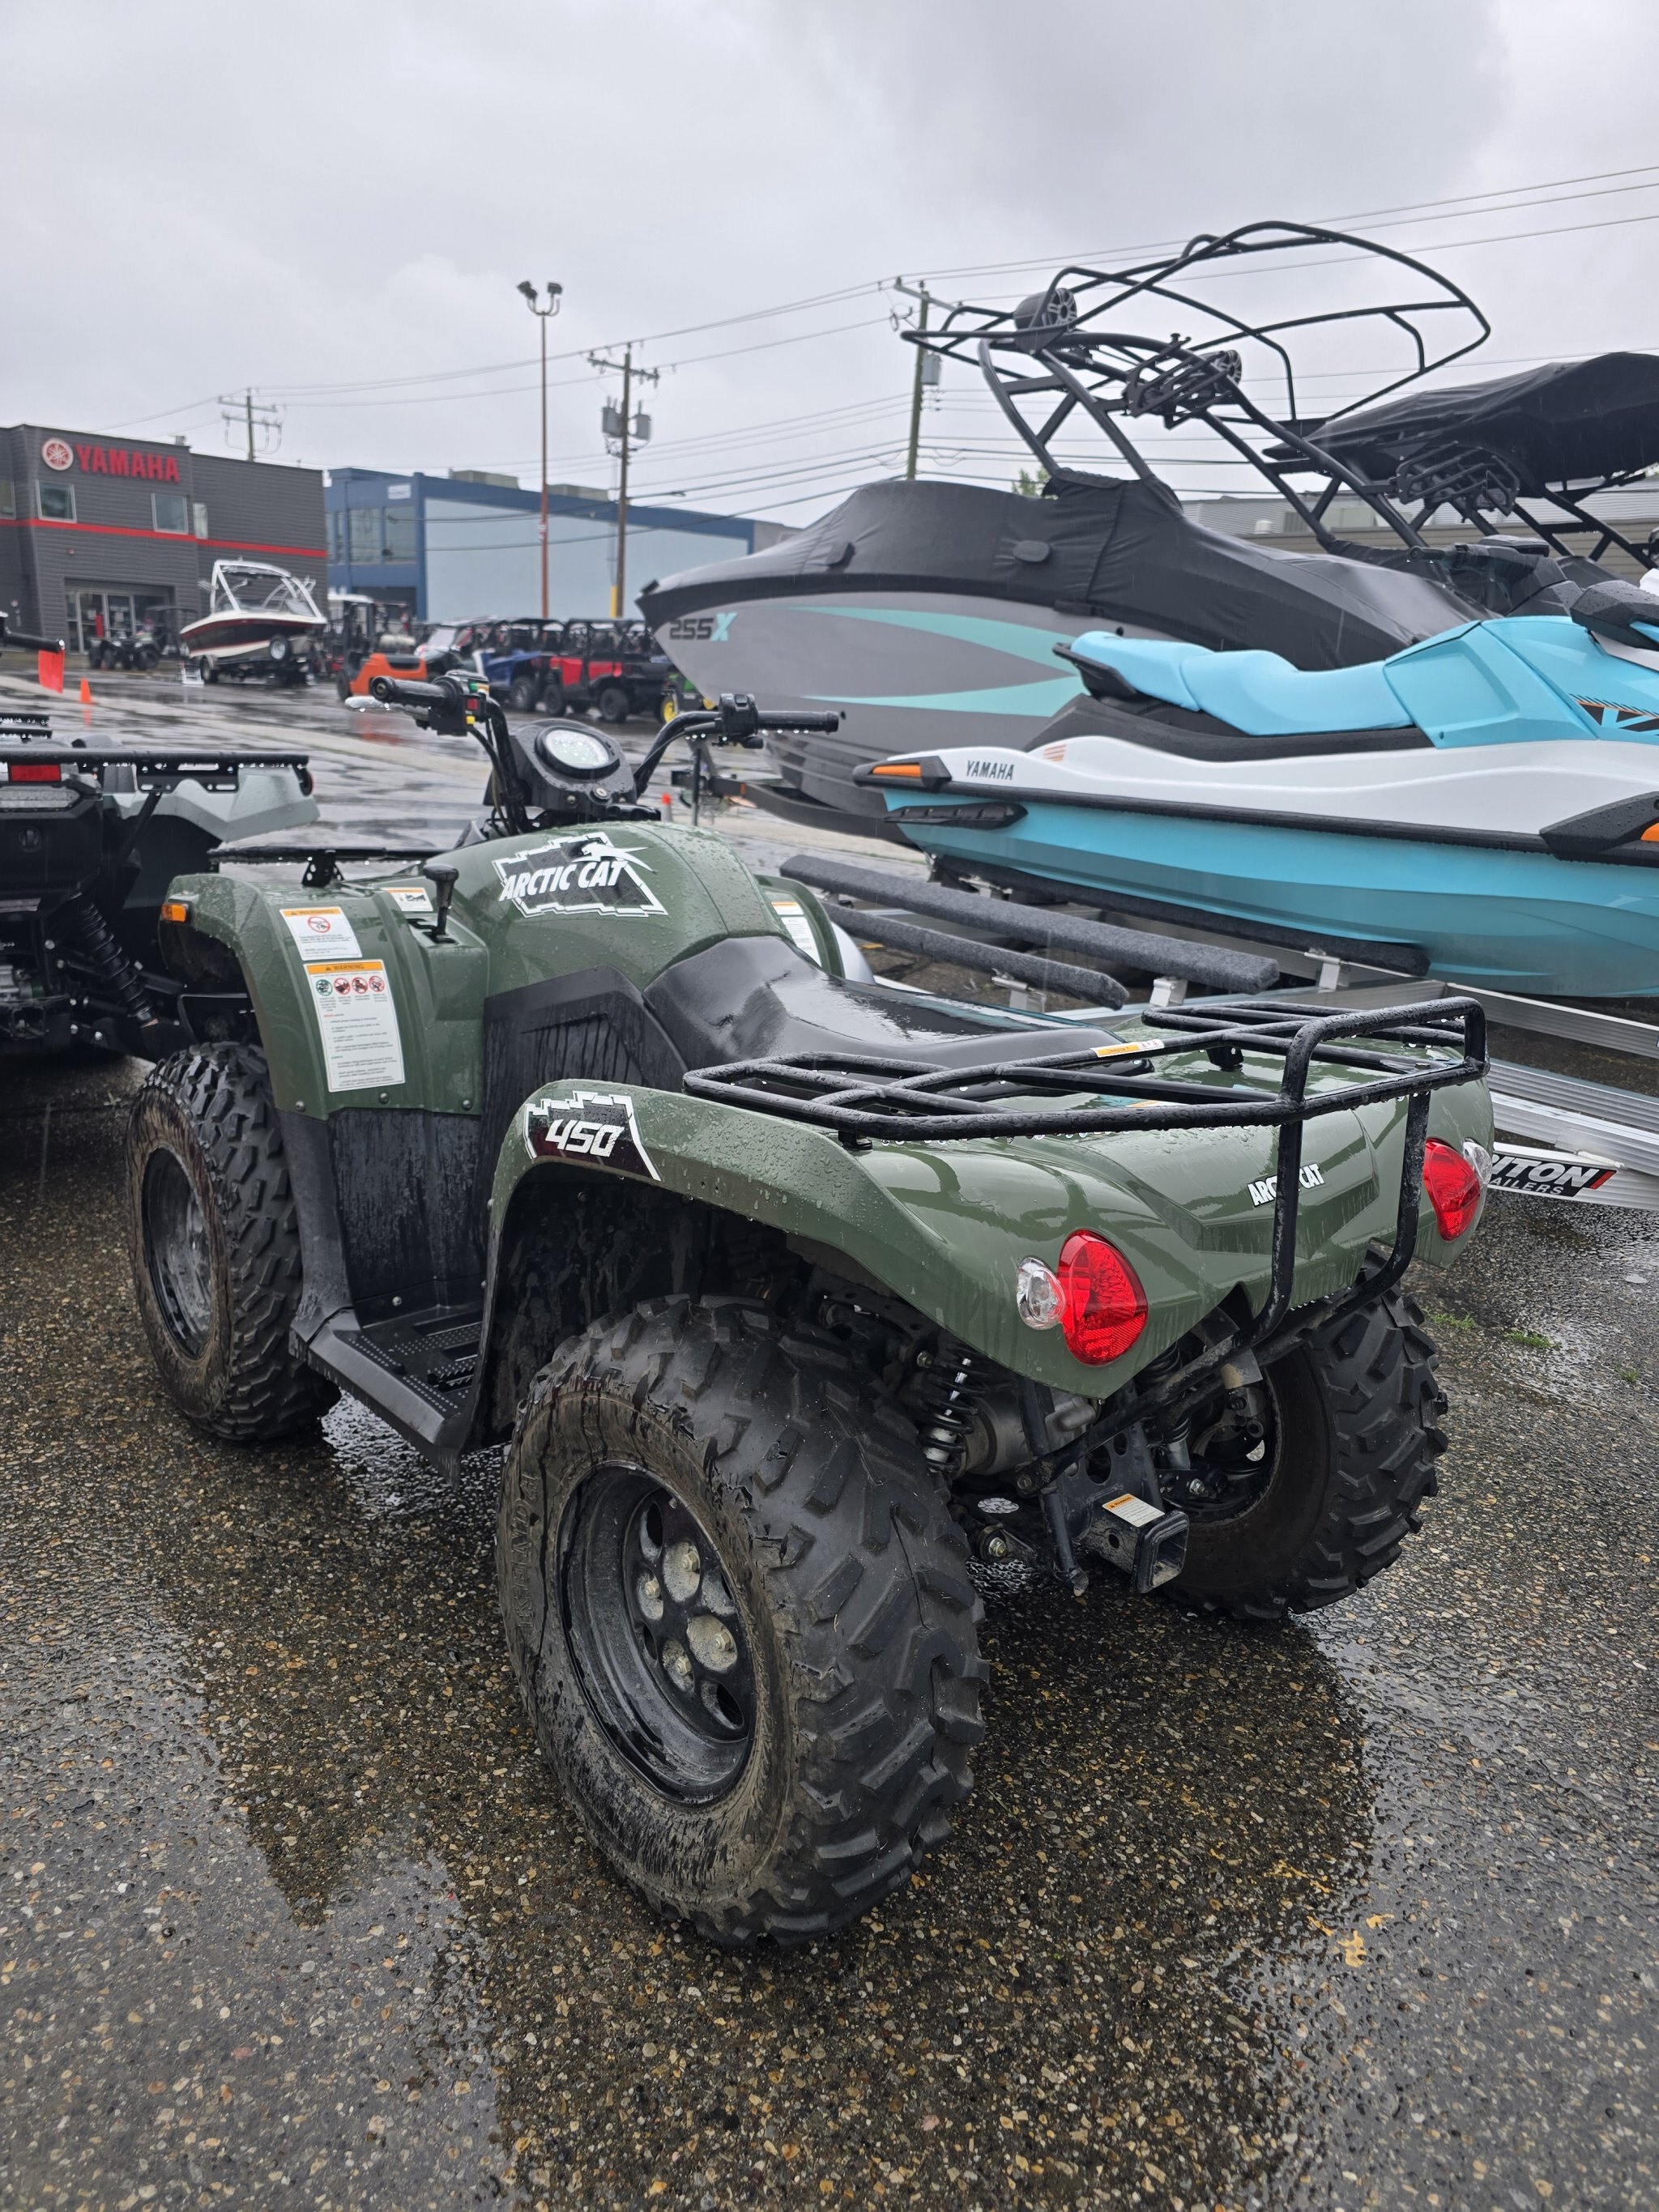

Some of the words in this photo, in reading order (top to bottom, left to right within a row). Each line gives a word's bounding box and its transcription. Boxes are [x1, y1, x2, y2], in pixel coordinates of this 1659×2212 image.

[75, 442, 181, 484] YAMAHA
[669, 612, 738, 642] 255X
[966, 760, 1014, 781] YAMAHA
[498, 863, 577, 901] ARCTIC
[578, 860, 629, 889] CAT
[544, 1119, 625, 1157] 450
[1247, 1173, 1297, 1208] ARC
[1299, 1163, 1325, 1189] CAT
[1490, 1177, 1565, 1196] AILERS
[1492, 1154, 1600, 1188] ITON
